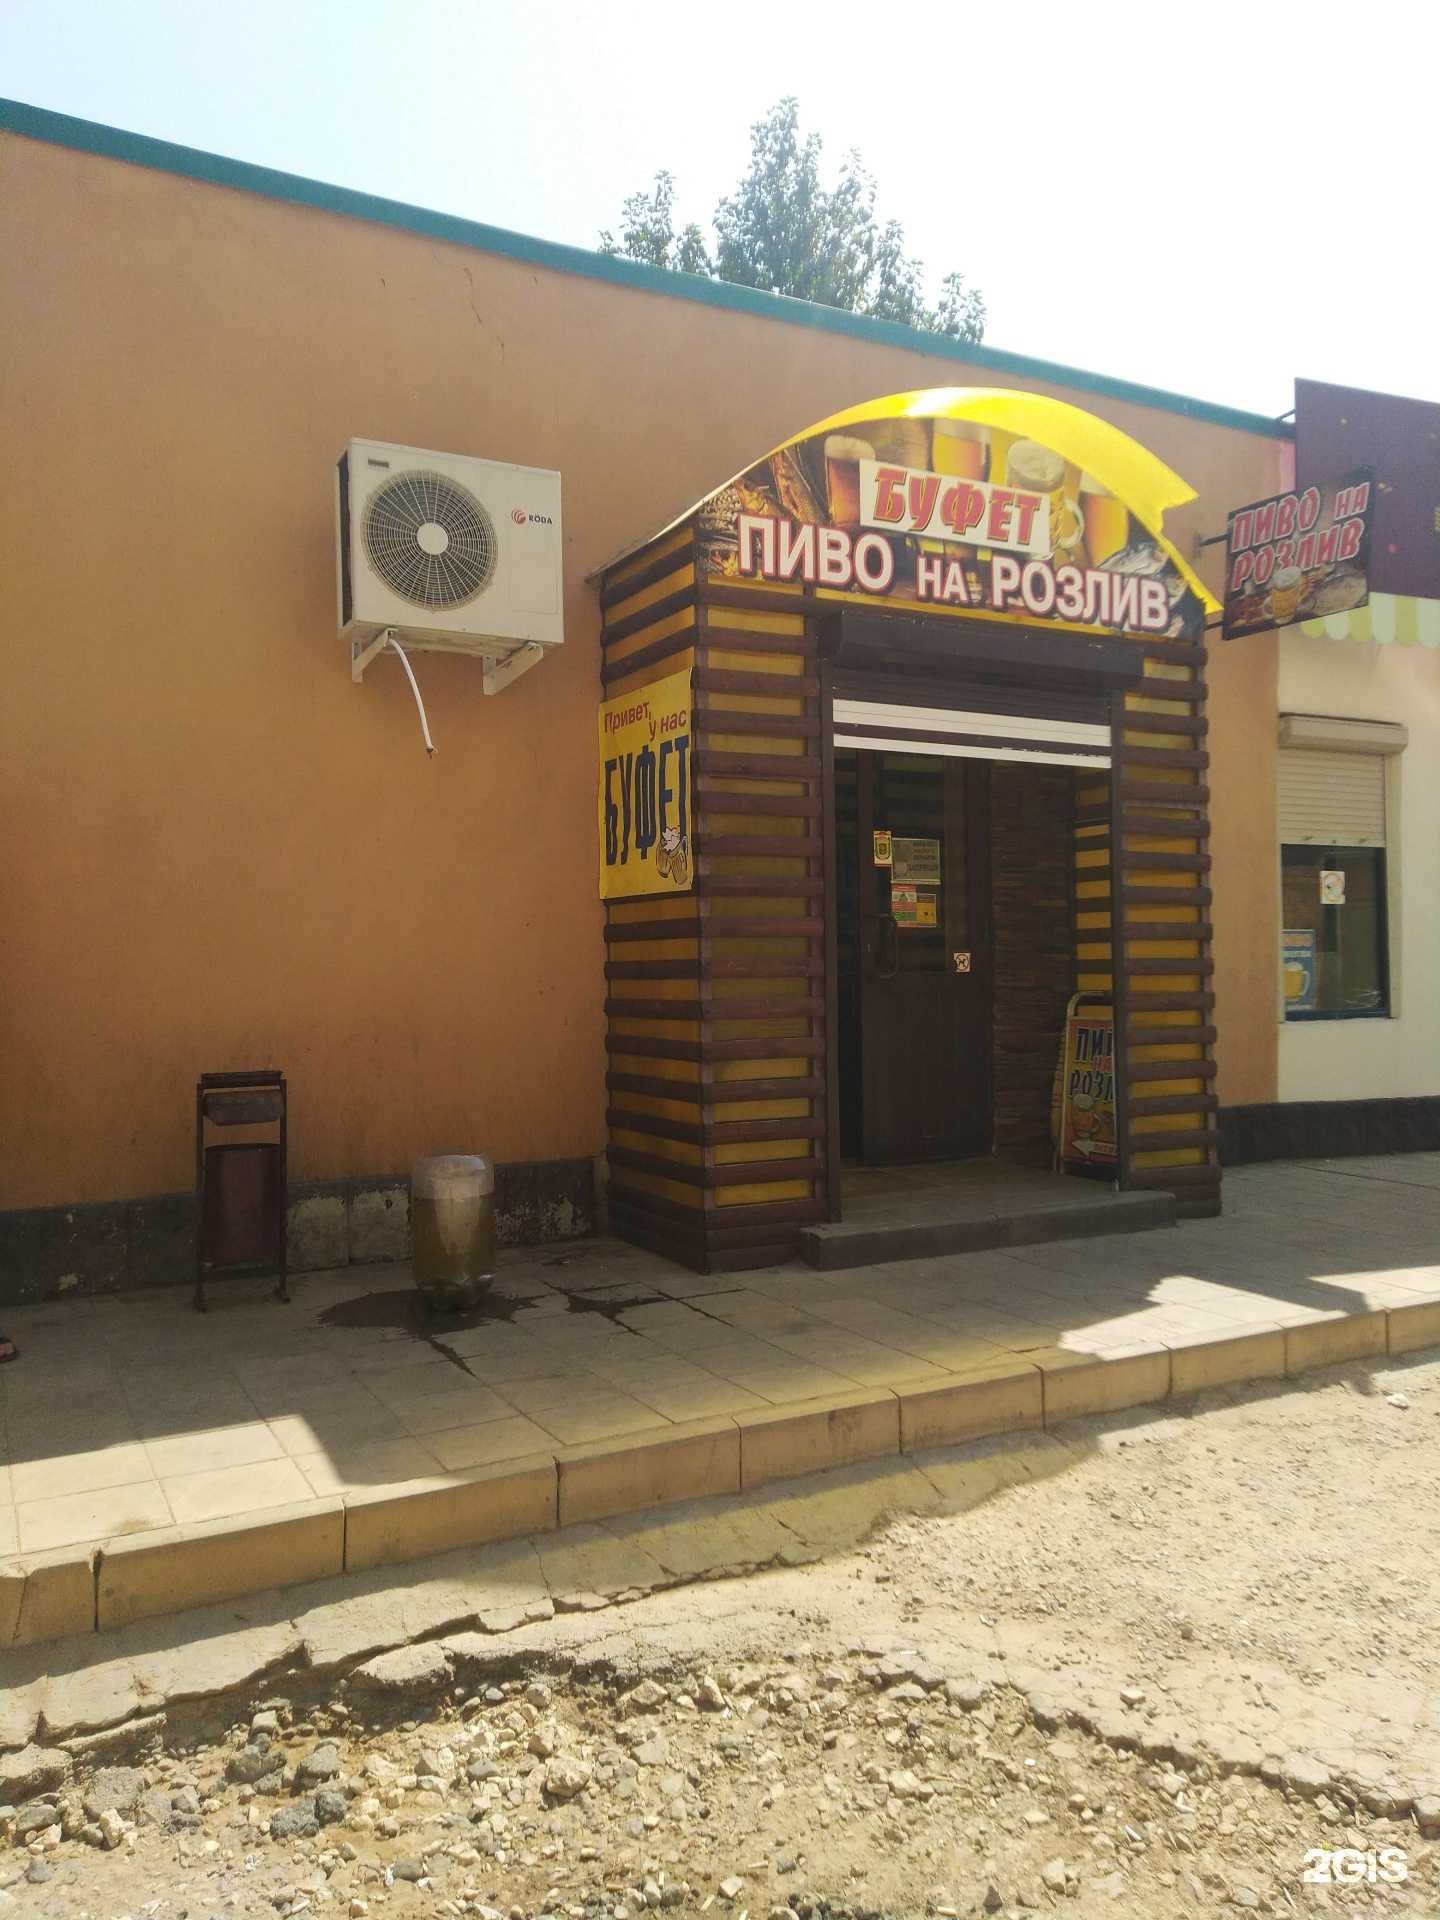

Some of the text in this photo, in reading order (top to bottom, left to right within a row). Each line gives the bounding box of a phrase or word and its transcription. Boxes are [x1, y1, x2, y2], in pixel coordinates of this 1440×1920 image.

[873, 467, 1042, 545] БУФЕТ
[1230, 482, 1370, 553] ПИВО НА
[737, 514, 1171, 632] ПИВО НА РОЗЛИВ
[1231, 518, 1365, 592] РОЗЛИВ
[660, 709, 687, 733] нас
[605, 734, 689, 867] БУФЕТ
